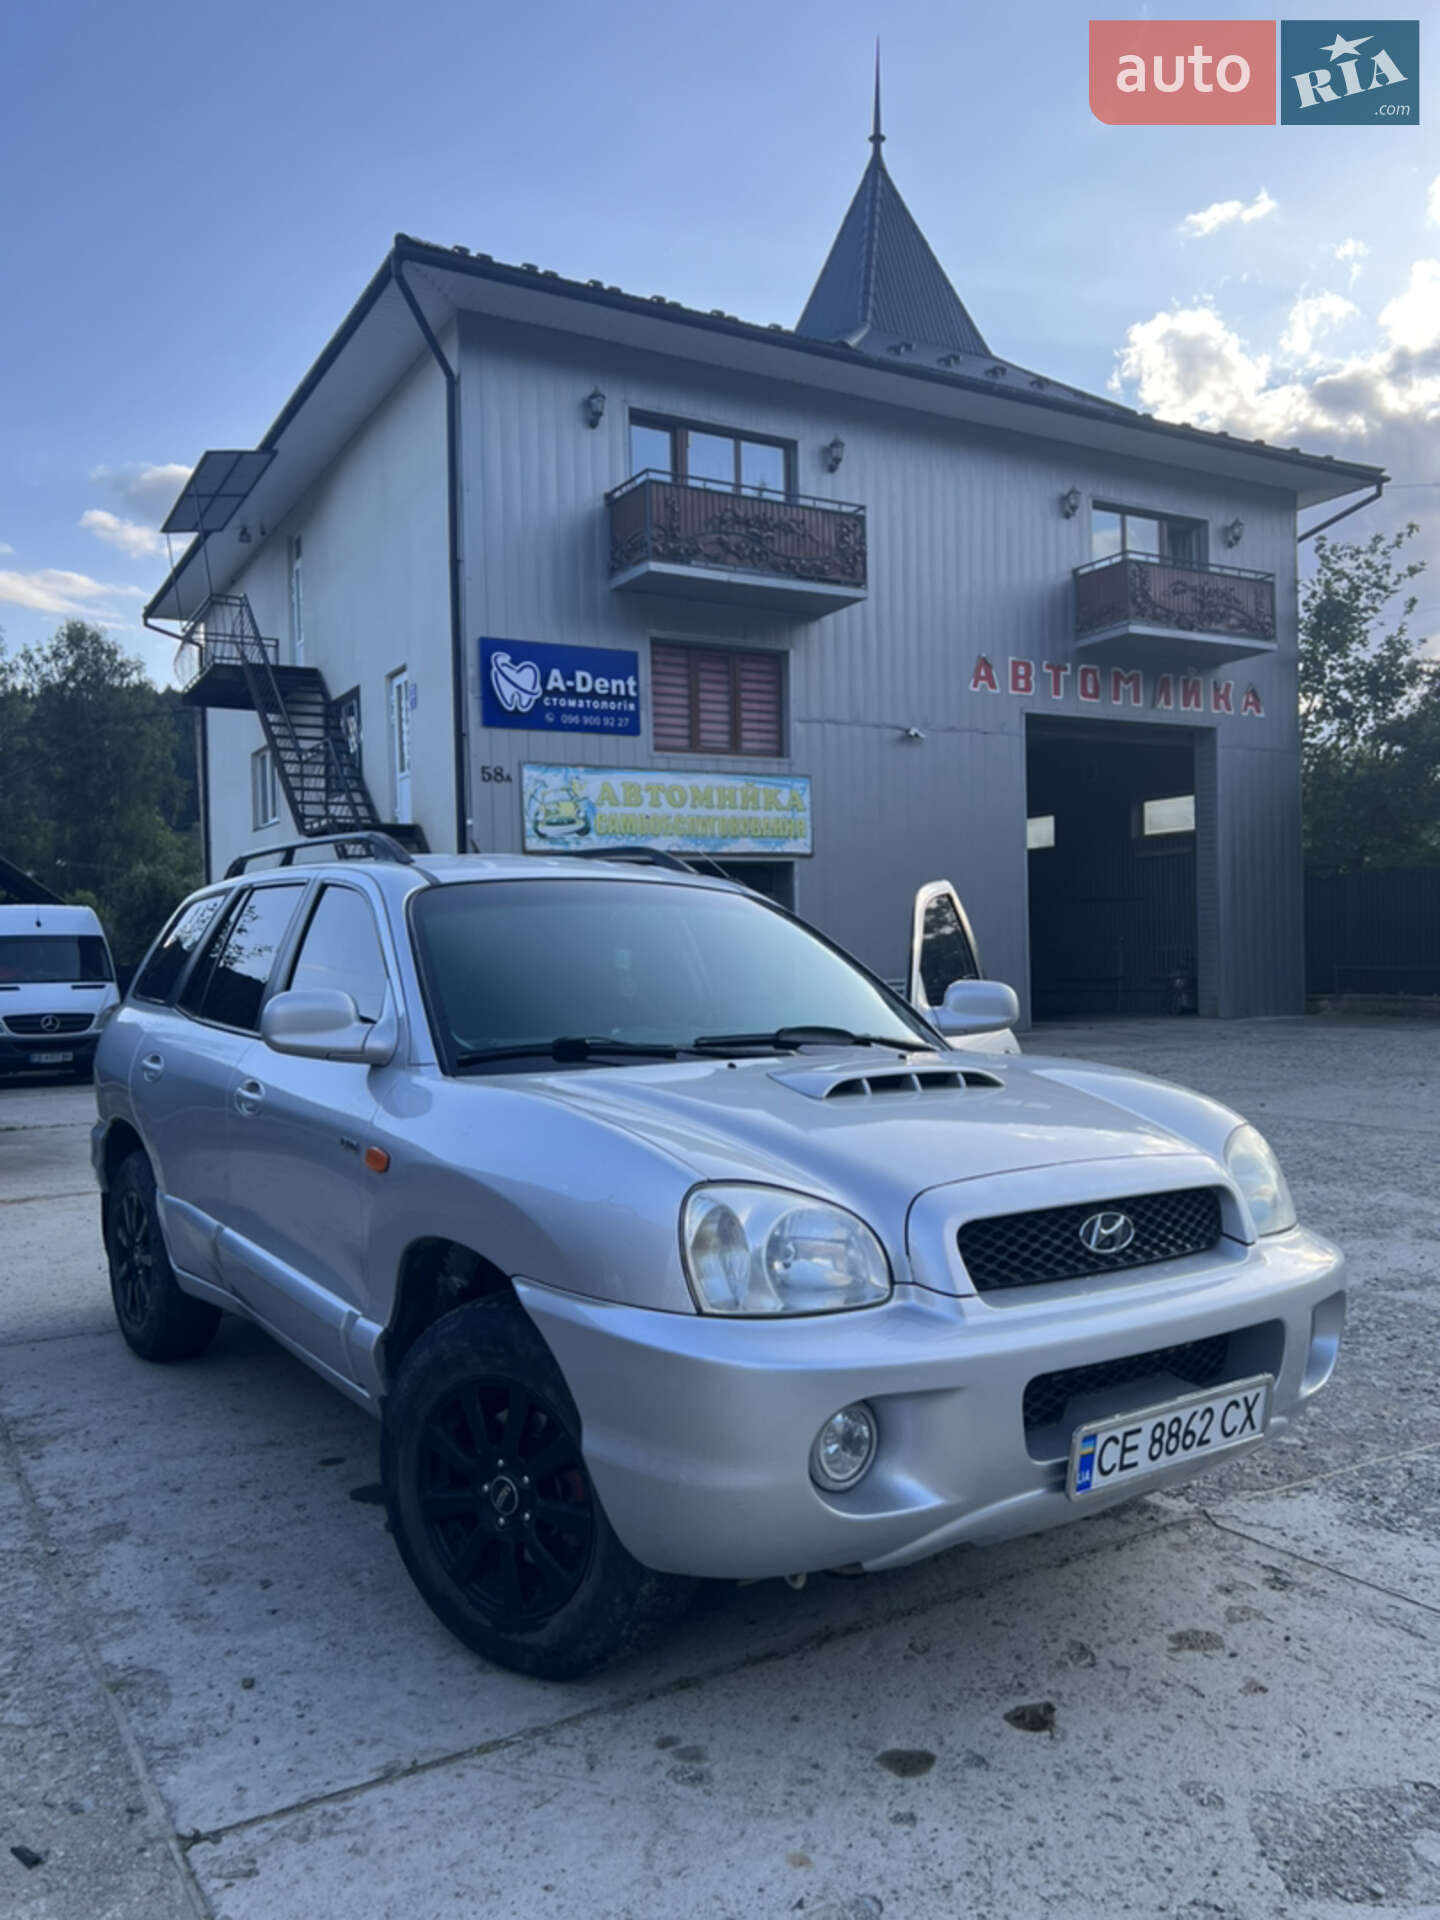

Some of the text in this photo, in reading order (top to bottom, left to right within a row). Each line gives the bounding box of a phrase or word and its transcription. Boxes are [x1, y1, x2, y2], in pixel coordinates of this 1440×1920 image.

[546, 668, 637, 697] A-Dent
[595, 781, 807, 812] АВТОМИЙКА
[1097, 1392, 1261, 1477] CE 8862 CX
